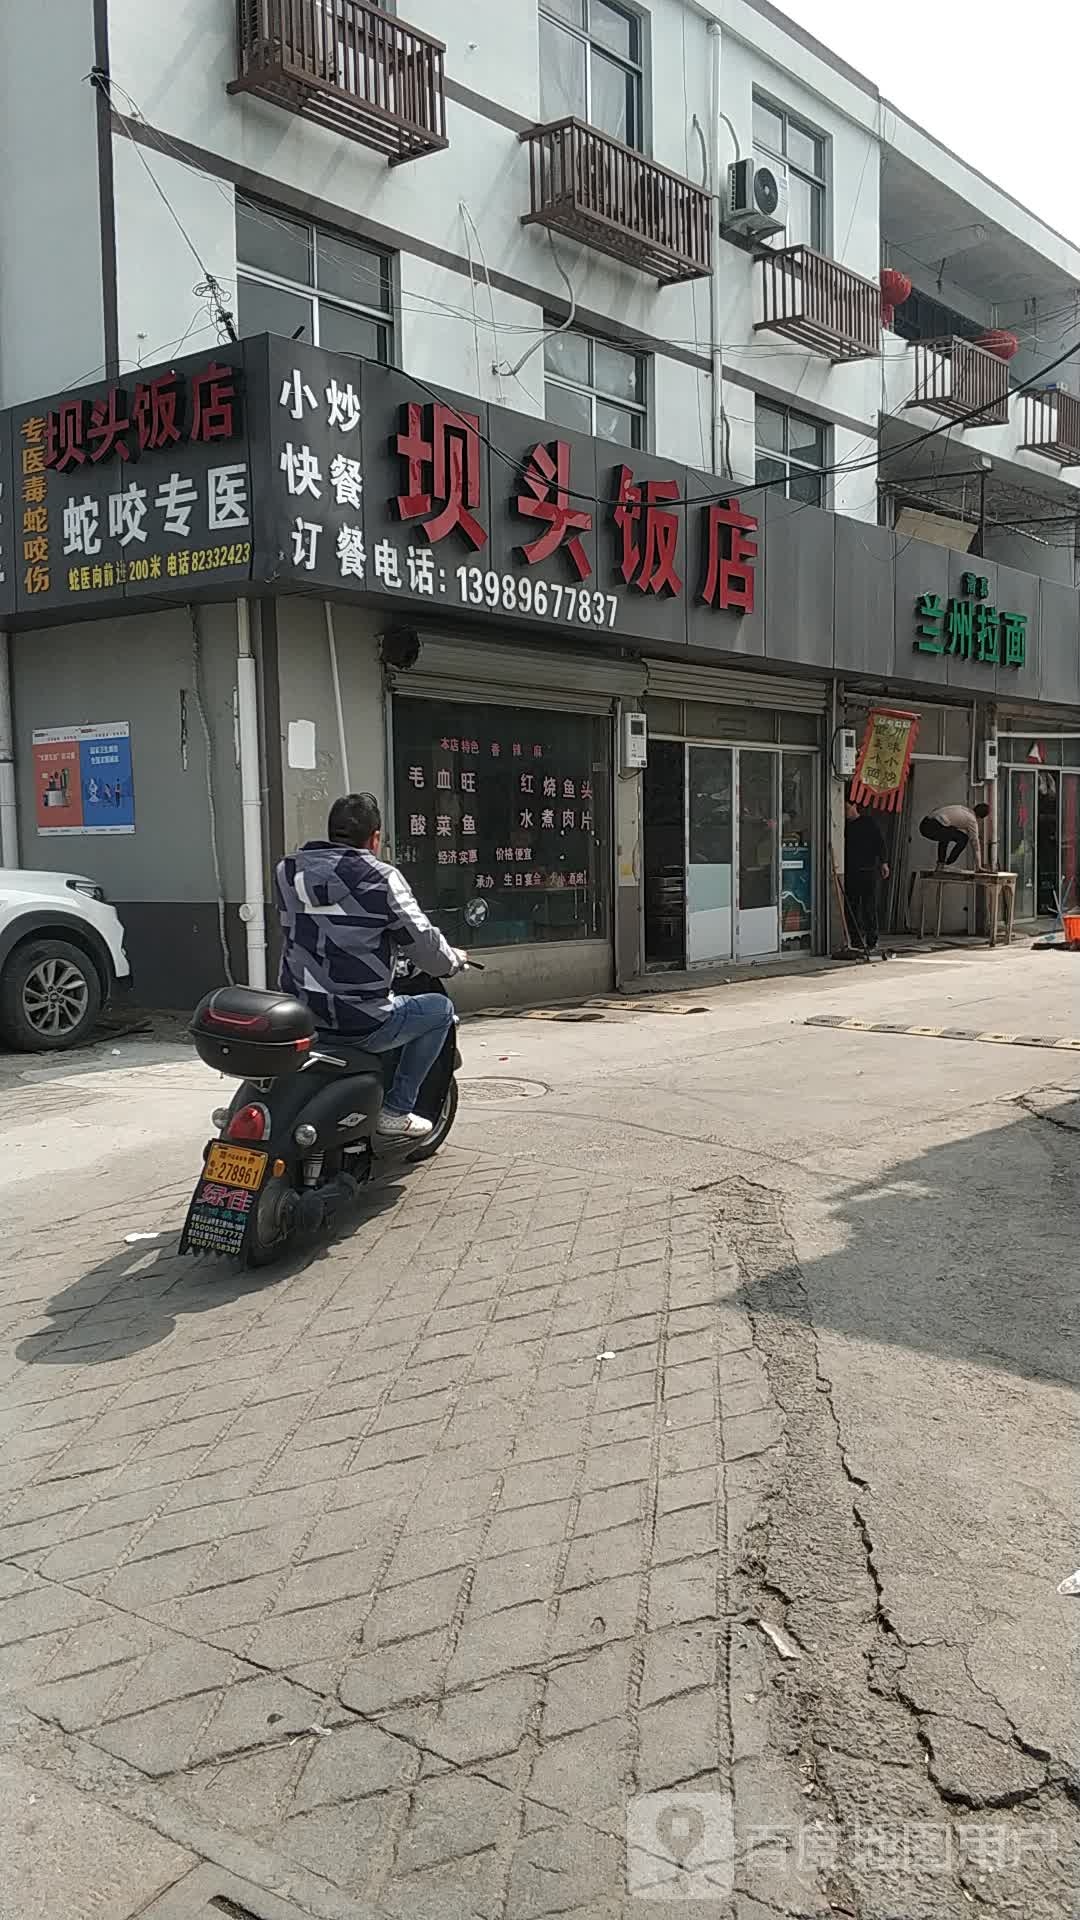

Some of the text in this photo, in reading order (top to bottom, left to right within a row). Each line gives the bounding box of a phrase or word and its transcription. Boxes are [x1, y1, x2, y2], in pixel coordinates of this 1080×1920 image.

[45, 362, 235, 472] 坝头饭店
[280, 369, 361, 432] 小炒
[21, 416, 50, 594] 专医毒蛇咬伤
[280, 442, 364, 511] 快餐
[63, 463, 250, 556] 蛇咬专医
[397, 401, 760, 616] 坝头饭店
[914, 594, 1028, 667] 兰州拉面
[440, 737, 480, 754] 本店特色
[408, 766, 476, 793] 毛血旺
[520, 773, 593, 799] 红烧鱼头
[410, 814, 476, 837] 酸菜鱼
[520, 808, 593, 831] 水煮肉片
[438, 848, 532, 864] 经济实惠 价格便宜
